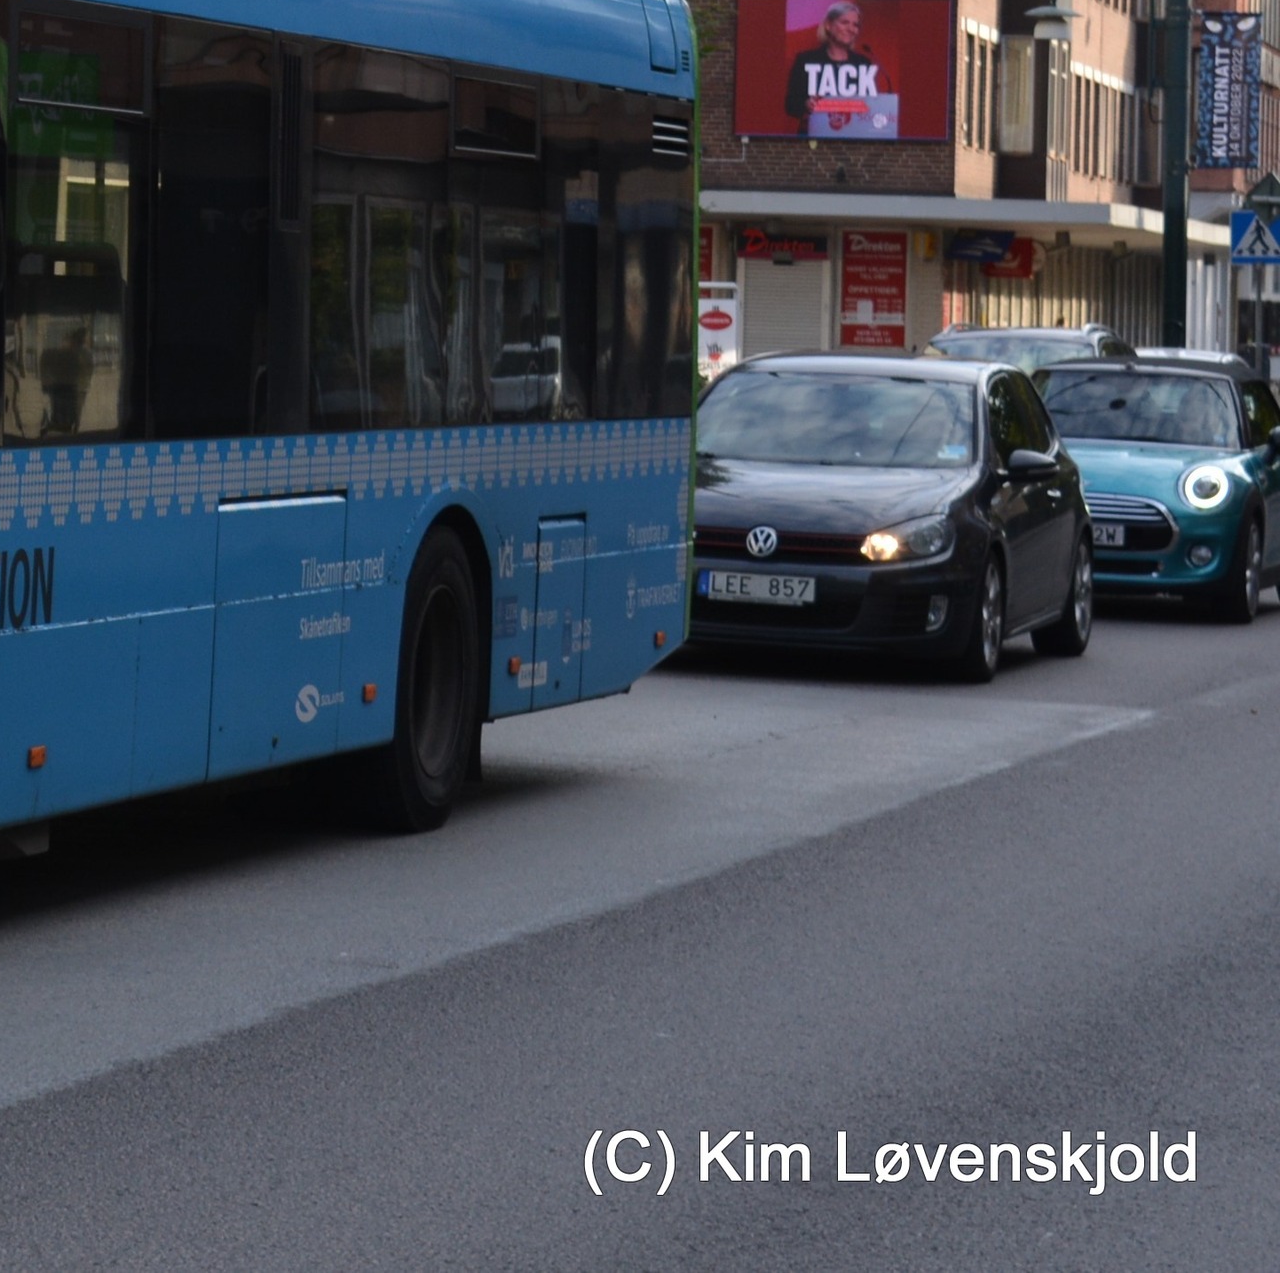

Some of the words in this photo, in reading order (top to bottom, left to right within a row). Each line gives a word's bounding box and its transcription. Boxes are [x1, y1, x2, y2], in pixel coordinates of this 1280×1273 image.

[804, 63, 878, 97] TACK
[1231, 47, 1243, 82] 2022
[1212, 45, 1230, 157] KULTURNATT
[1230, 83, 1242, 140] OKTOBER
[849, 234, 901, 252] Direkten
[301, 557, 361, 589] Tillsammans
[363, 548, 385, 581] med
[711, 574, 751, 595] LEE
[769, 578, 809, 598] 857
